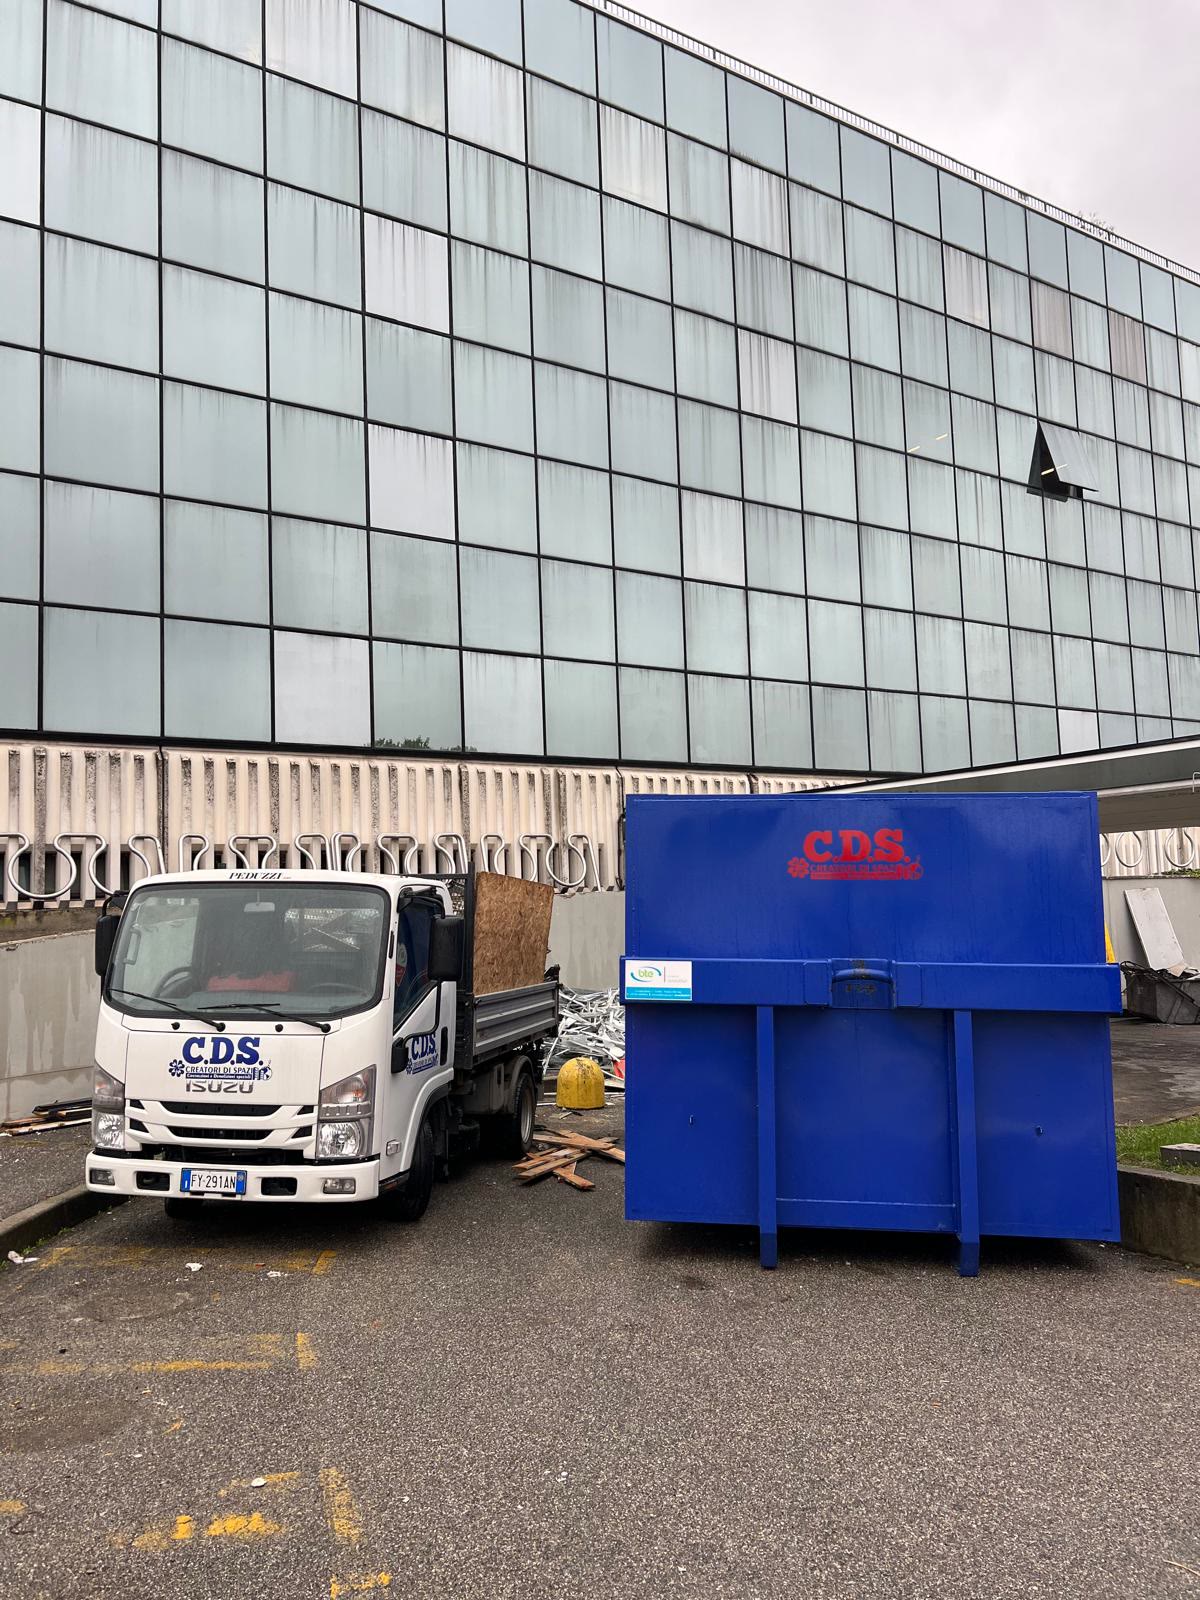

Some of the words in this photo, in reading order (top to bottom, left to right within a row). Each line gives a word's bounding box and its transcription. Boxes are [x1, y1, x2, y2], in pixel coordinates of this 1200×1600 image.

[804, 828, 910, 862] C.D.S.
[182, 1036, 264, 1065] C.D.S.
[186, 1080, 254, 1093] ISUZU
